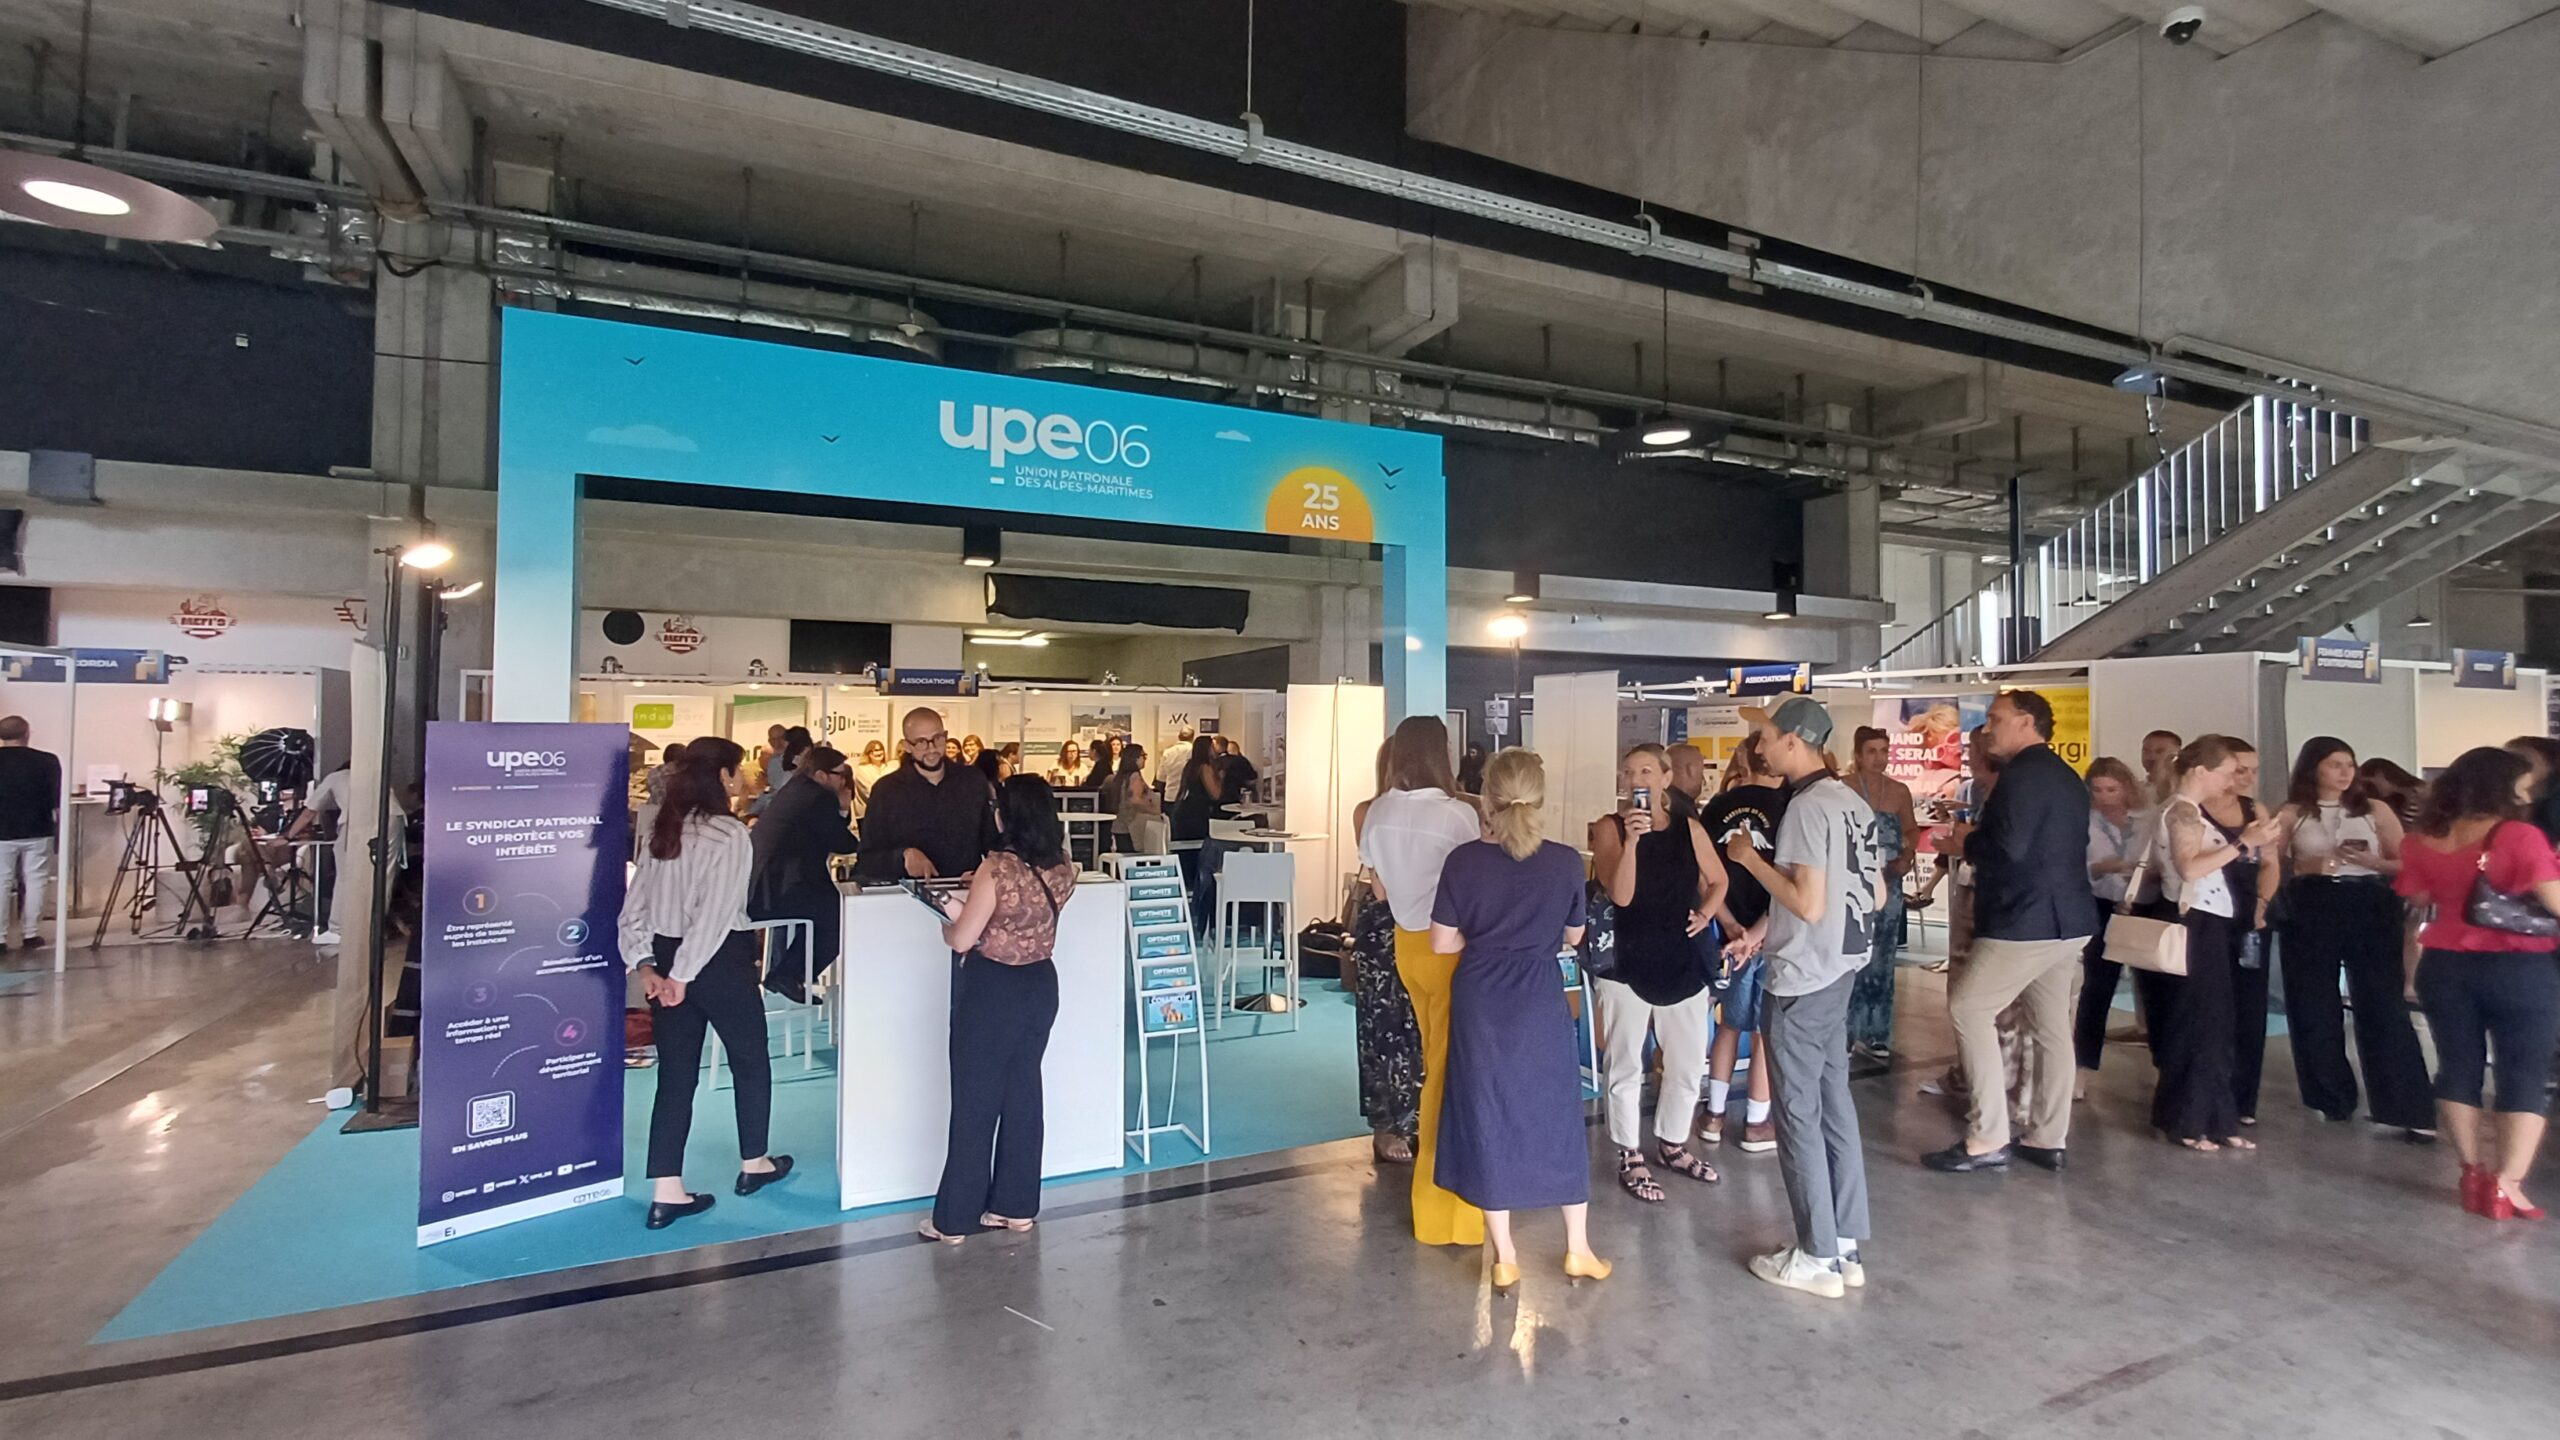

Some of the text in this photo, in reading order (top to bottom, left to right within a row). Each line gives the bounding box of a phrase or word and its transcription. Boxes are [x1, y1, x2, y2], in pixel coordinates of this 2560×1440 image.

[940, 400, 1150, 468] upe06
[1015, 465, 1133, 486] UNION PATRONALE
[1015, 476, 1154, 499] DES ALPES-MARITIMES
[1303, 483, 1340, 511] 25
[1301, 513, 1340, 530] ANS
[900, 677, 956, 685] ASSOCIATIONS
[1745, 674, 1792, 684] ASSOCIATIONS
[487, 751, 567, 771] upe06
[1884, 764, 1924, 776] RAND
[446, 816, 603, 831] LE SYNDICAT PATRONAL
[466, 830, 585, 846] QUI PROTÈGE VOS
[495, 844, 557, 857] INTÉRÊTS
[475, 894, 486, 909] 1
[475, 930, 487, 939] de
[488, 928, 516, 937] toutes
[566, 925, 580, 940] 2
[452, 940, 465, 948] les
[474, 987, 488, 1003] 3
[562, 1024, 578, 1039] 4
[452, 1132, 528, 1154] EN SAVOIR PLUS
